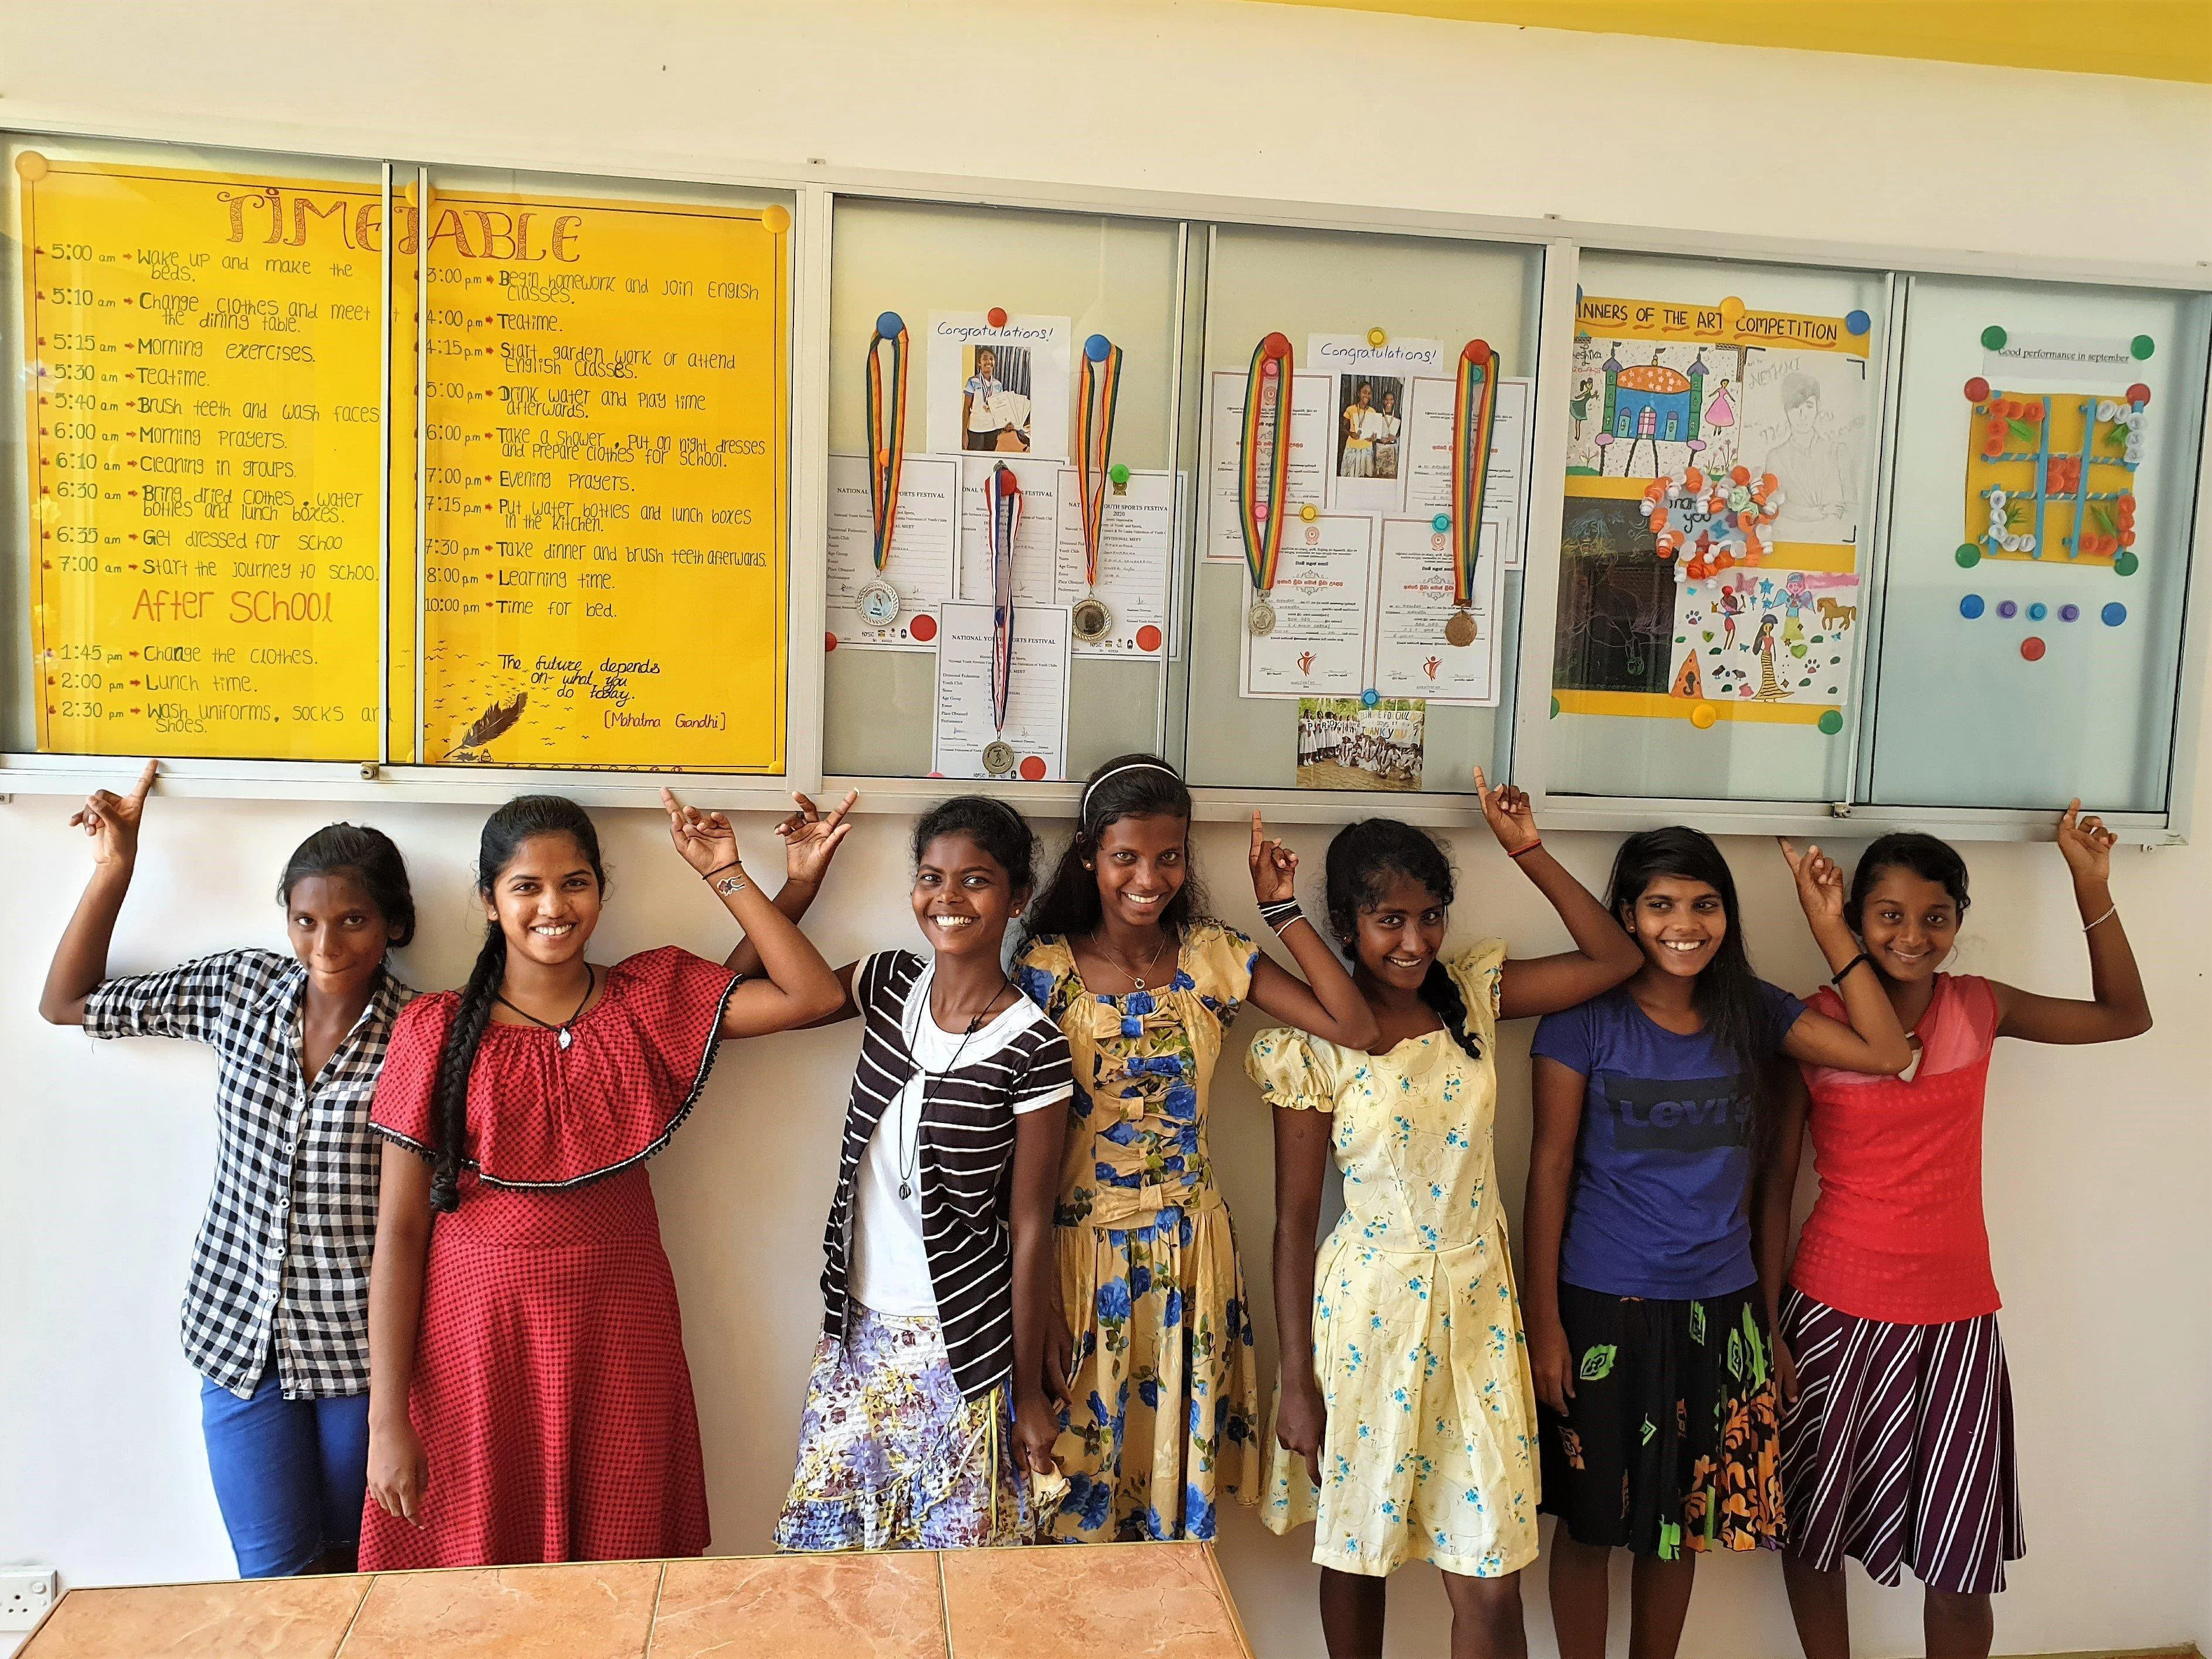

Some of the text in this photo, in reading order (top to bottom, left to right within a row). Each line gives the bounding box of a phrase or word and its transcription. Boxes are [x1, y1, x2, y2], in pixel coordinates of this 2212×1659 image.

[52, 243, 353, 277] 5:00 Wake and make the
[151, 266, 196, 281] beds.
[498, 271, 649, 293] Begin homework and
[52, 287, 371, 321] 5:10 Change clothes and meet
[507, 286, 575, 304] classes.
[162, 310, 301, 333] the dining table.
[496, 314, 563, 333] Teatime.
[937, 321, 1054, 342] Congratulations!
[1577, 303, 1837, 340] INNERS OF THE ART COMPETITION
[53, 335, 316, 363] 5:15 Morning exercises.
[500, 342, 537, 361] Start
[552, 345, 603, 362] garden
[615, 348, 652, 365] work
[663, 351, 678, 367] or
[687, 352, 735, 369] attend
[1321, 342, 1437, 365] Congratulations!
[2024, 350, 2075, 359] performance
[2088, 354, 2129, 362] september
[54, 364, 210, 387] 5:30 Teatime.
[505, 358, 562, 375] English
[427, 381, 706, 410] 5:00 Drink water and time
[55, 394, 96, 409] 5:40
[137, 396, 182, 415] Brush
[193, 401, 232, 416] teeth
[243, 402, 267, 419] and
[282, 404, 320, 422] wash
[507, 402, 589, 418] afterwards.
[54, 423, 201, 446] 6:00 Morning
[426, 425, 765, 455] 6:00 Take on night dresses
[56, 452, 230, 476] 6:10 Cleaning in
[501, 443, 525, 459] and
[586, 446, 635, 462] clothes
[645, 449, 669, 464] for
[426, 467, 551, 489] 7:00 Evening
[57, 481, 363, 508] 6:30 Bring dried water
[143, 501, 345, 524] bottles and lunch boxes.
[426, 496, 752, 525] 7:15 Put water bottles and lunch boxes
[505, 514, 543, 530] in the
[1684, 513, 1712, 534] you
[56, 525, 280, 549] 6:35 Get dressed for
[496, 541, 767, 567] Take dinner and brush teeth afterwards.
[60, 556, 315, 579] 7:00 Start the journey to
[428, 566, 615, 591] 8:00 Learning time.
[133, 588, 214, 621] After
[425, 597, 618, 618] 10:00 Time for bed.
[60, 643, 318, 665] 1:45 Change the clothes.
[498, 654, 660, 676] The future depends
[61, 672, 257, 693] 2:00 Lunch time.
[530, 671, 628, 690] on what you
[557, 686, 636, 707] do today.
[62, 701, 344, 723] 2:30 Wash socks
[155, 718, 208, 734] shoes.
